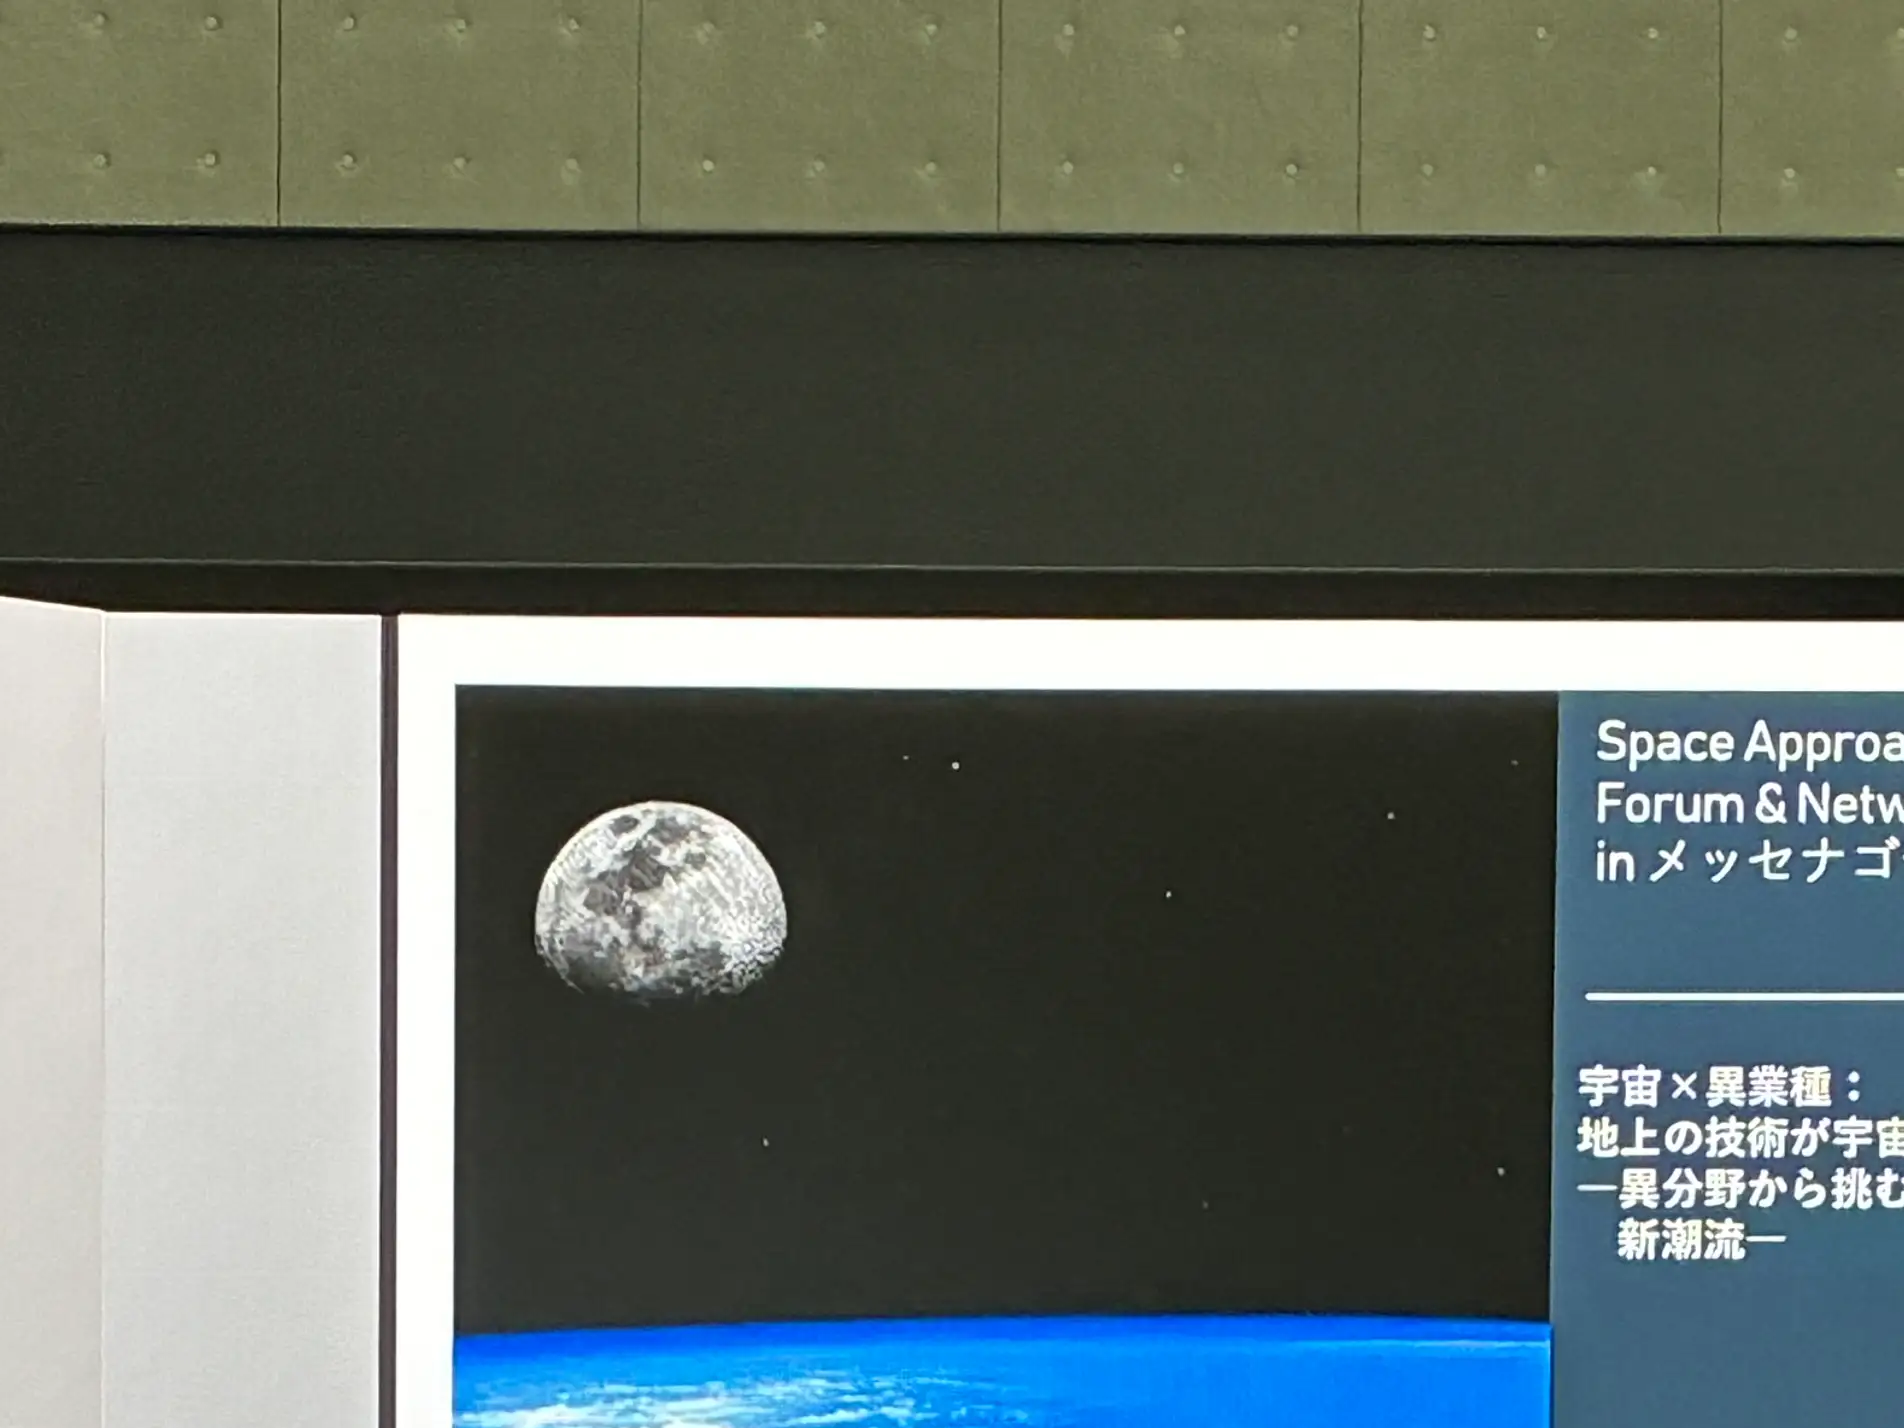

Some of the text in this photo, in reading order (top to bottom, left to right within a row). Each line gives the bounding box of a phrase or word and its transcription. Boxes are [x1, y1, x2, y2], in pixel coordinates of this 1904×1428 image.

[1596, 719, 1735, 773] Space
[1597, 781, 1745, 824] Forum
[1754, 781, 1788, 825] &
[1596, 839, 1635, 882] in
